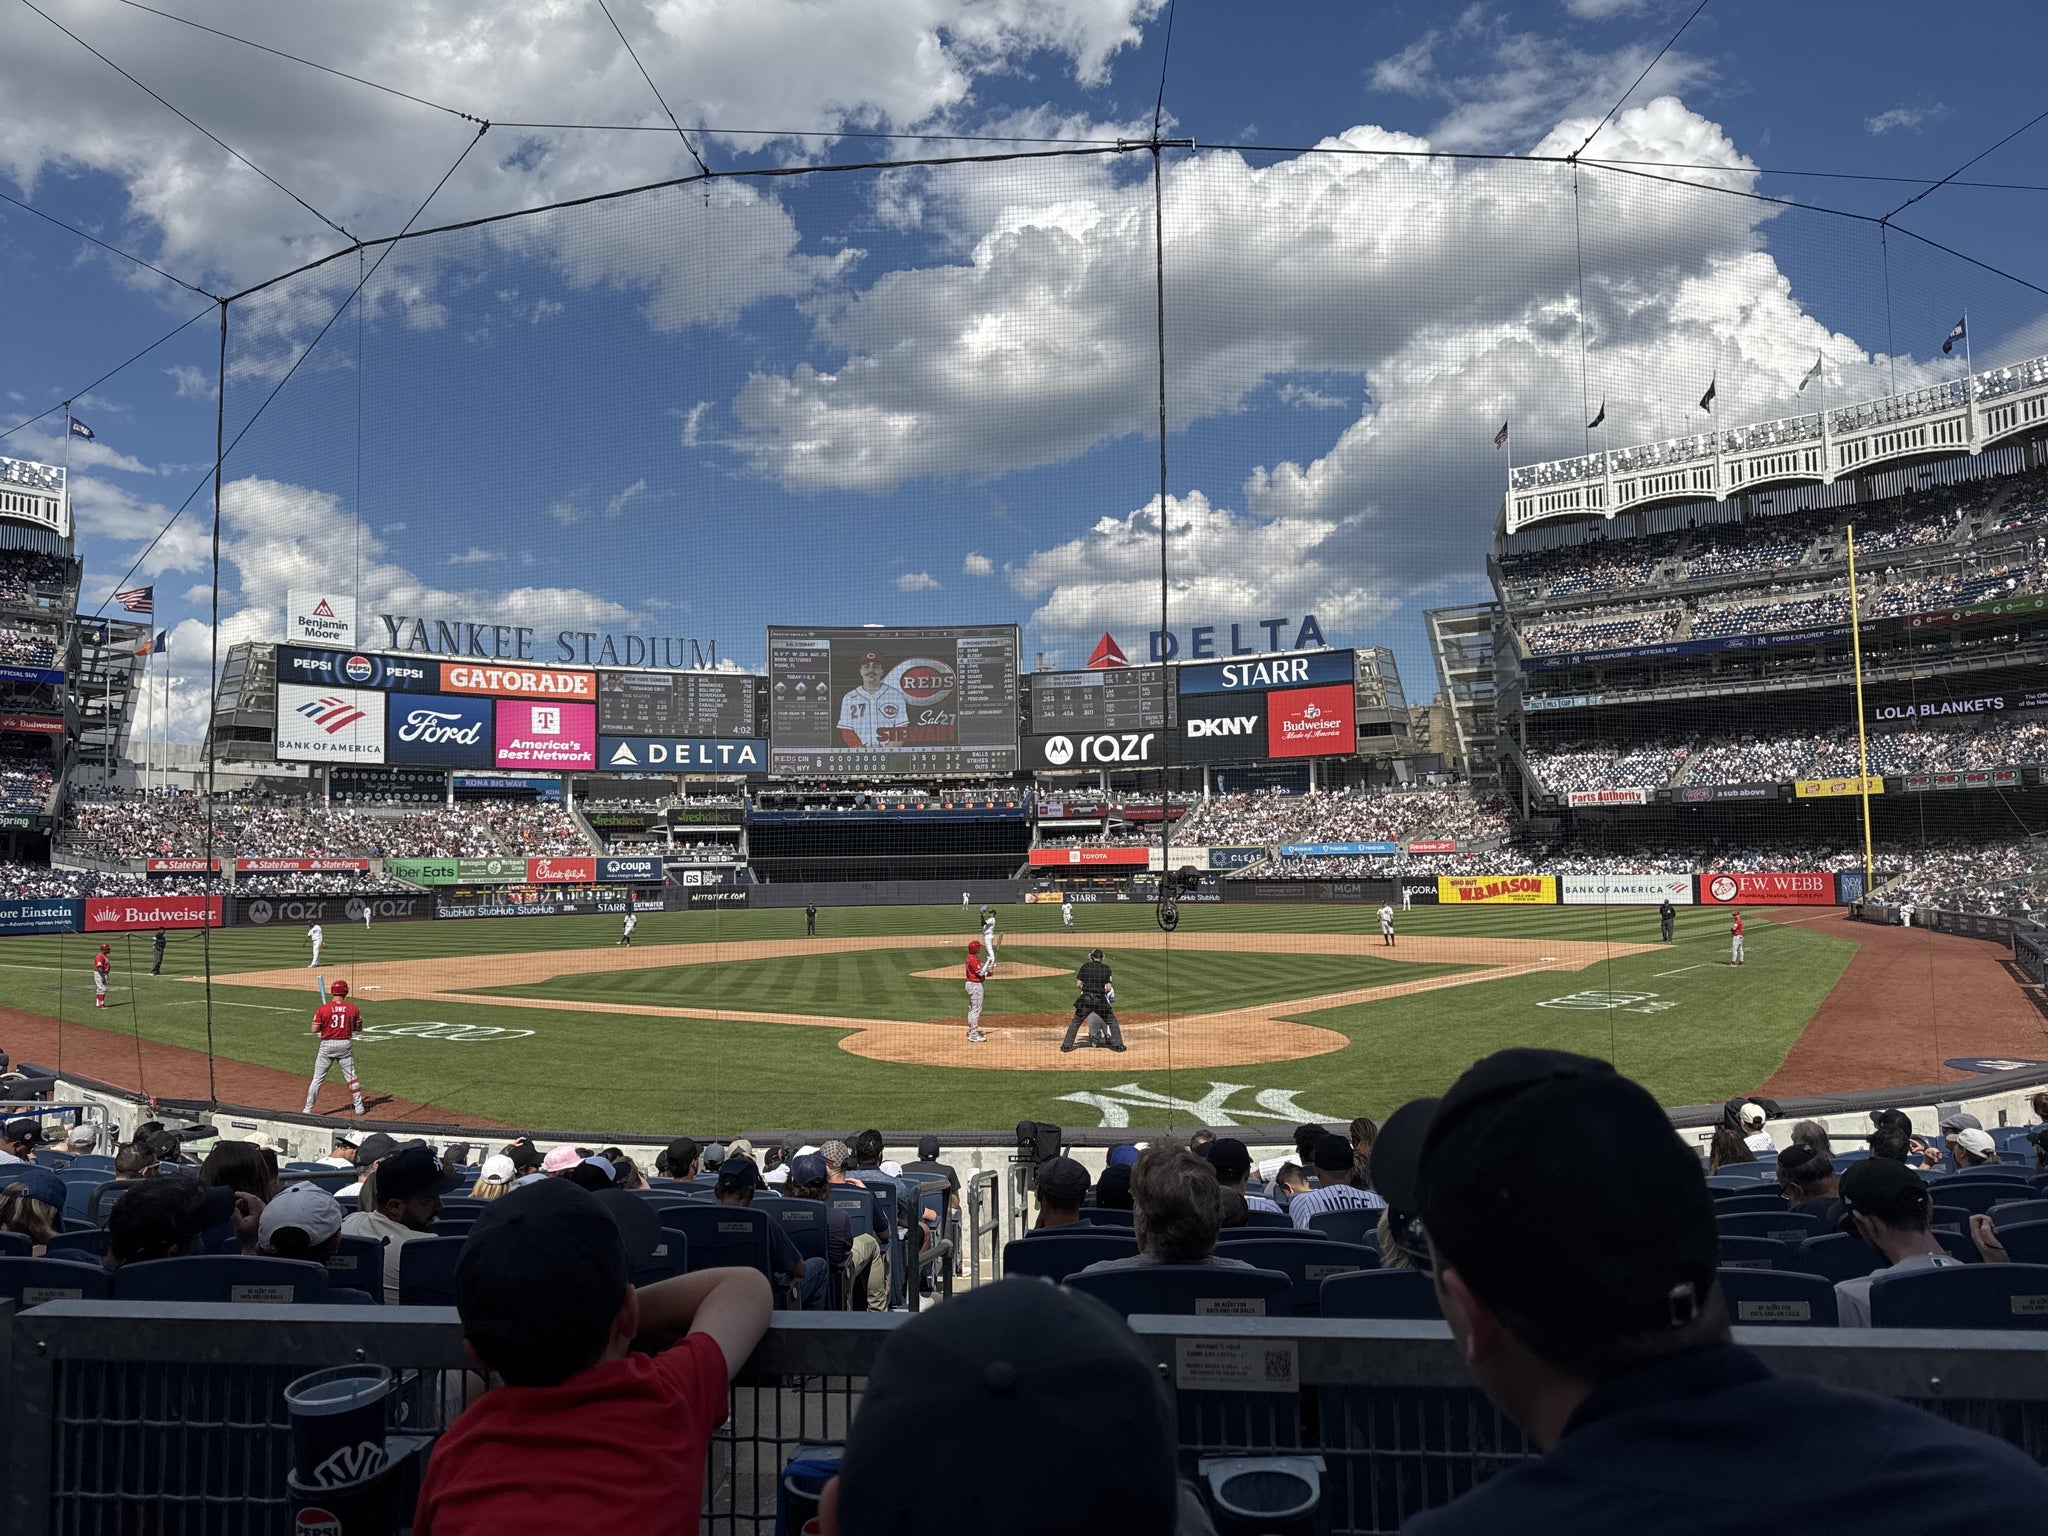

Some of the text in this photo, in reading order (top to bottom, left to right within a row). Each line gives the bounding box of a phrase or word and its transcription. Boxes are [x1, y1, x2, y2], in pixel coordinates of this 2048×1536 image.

[298, 616, 348, 631] Benjamin
[304, 627, 340, 639] Moore
[1149, 614, 1327, 662] DELTA
[379, 614, 718, 670] YANKEE STADIUM
[294, 658, 423, 679] PEPSI PEPSI PEPSI
[1222, 658, 1309, 688] STARR
[449, 667, 589, 694] GATORADE
[904, 676, 954, 689] REDS
[850, 704, 866, 719] 27
[1876, 697, 2004, 720] LOLA BLANKETS
[20, 720, 62, 729] Budweiser
[918, 710, 956, 726] Sal 27
[398, 710, 482, 745] Ford
[1188, 716, 1258, 738] DKNY
[1282, 719, 1341, 732] Budweiser
[1282, 730, 1340, 740] Made of America
[279, 740, 381, 754] BANK OF AMERICA
[509, 739, 581, 750] America's
[1080, 734, 1154, 762] razr
[498, 748, 592, 762] Best Network
[649, 744, 757, 764] DELTA
[1572, 791, 1641, 802] Parts Authority
[0, 814, 29, 828] Spring
[595, 814, 644, 826] freshdirect
[681, 810, 731, 822] freshdirect
[388, 866, 420, 878] Uber
[423, 866, 454, 877] Eats
[620, 862, 651, 872] coupa
[686, 874, 699, 883] GS
[1740, 877, 1823, 891] F.W. WEBB
[1334, 884, 1361, 893] MGM
[1716, 882, 1734, 895] WEBB
[692, 892, 746, 900] NITTOTIRE.COM
[22, 906, 72, 918] Einstein
[125, 907, 216, 923] Budweiser
[279, 902, 328, 920] razr
[371, 900, 417, 917] razr
[440, 905, 554, 918] StubHub StubHub StubHub
[598, 904, 626, 912] STARR
[331, 1014, 345, 1028] 31
